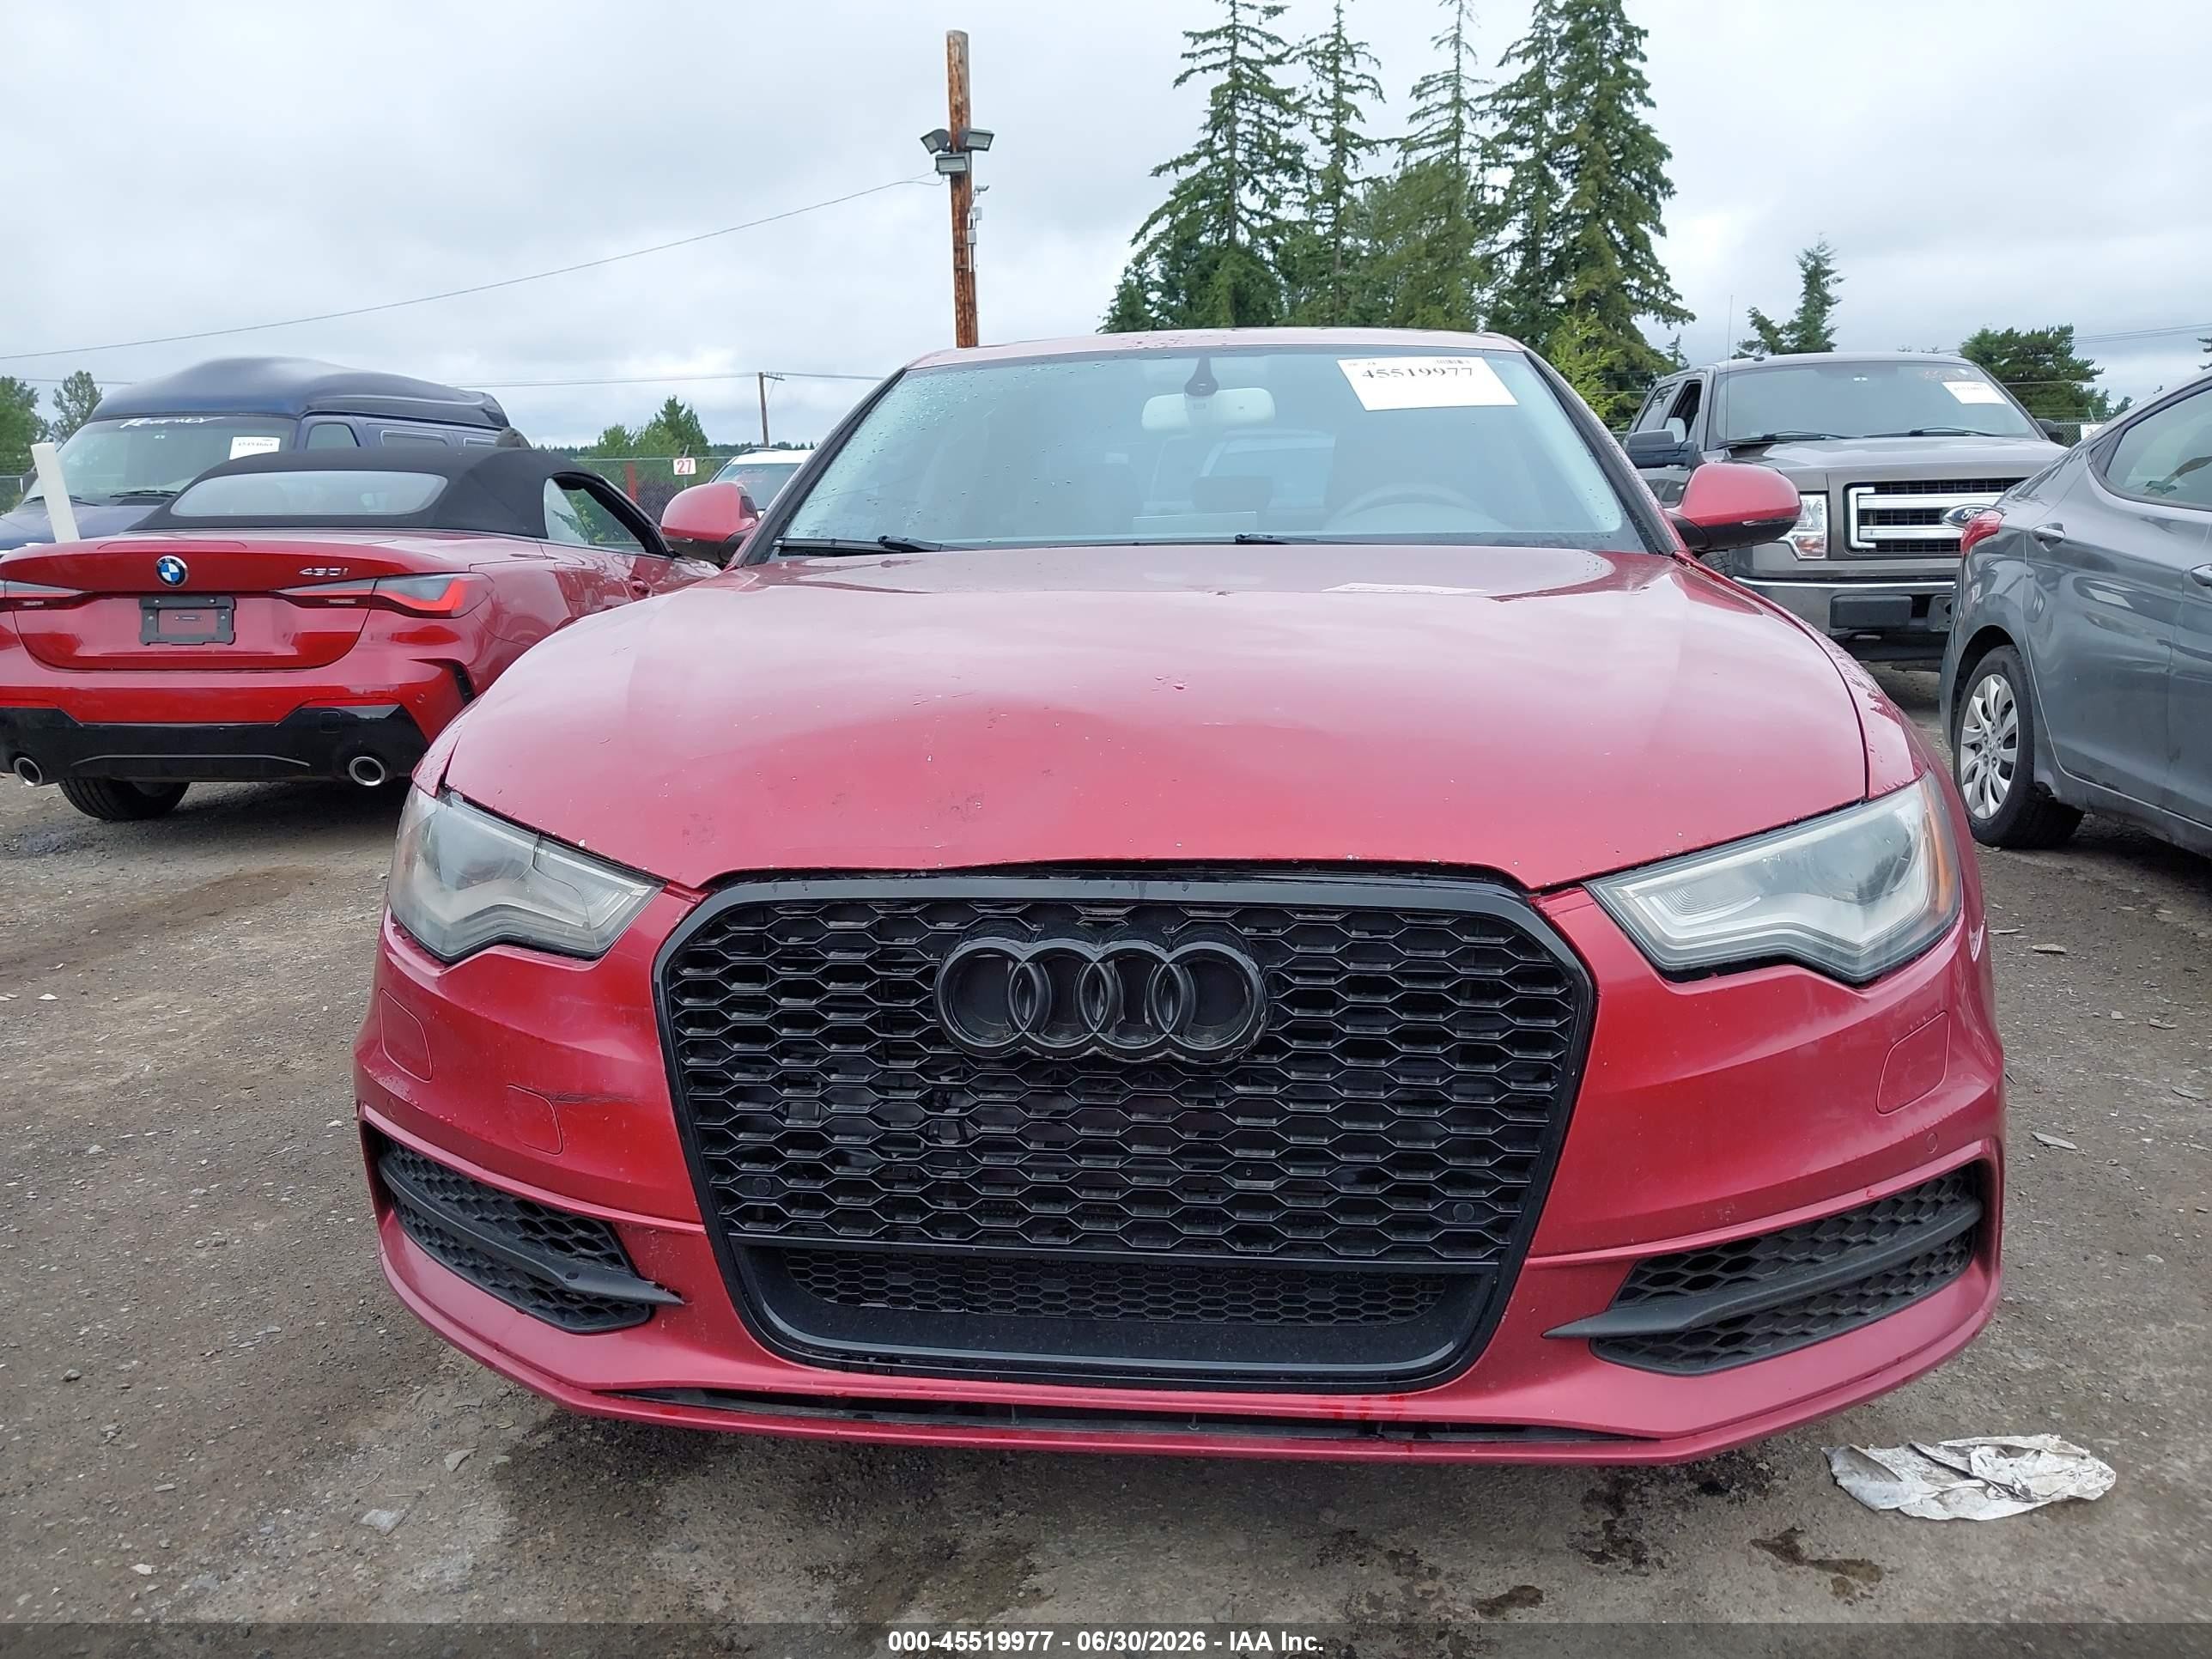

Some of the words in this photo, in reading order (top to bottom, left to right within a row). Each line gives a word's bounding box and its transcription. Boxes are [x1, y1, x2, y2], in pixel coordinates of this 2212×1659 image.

[1362, 367, 1474, 379] 45519977
[677, 459, 691, 473] 27
[299, 567, 349, 576] 430i
